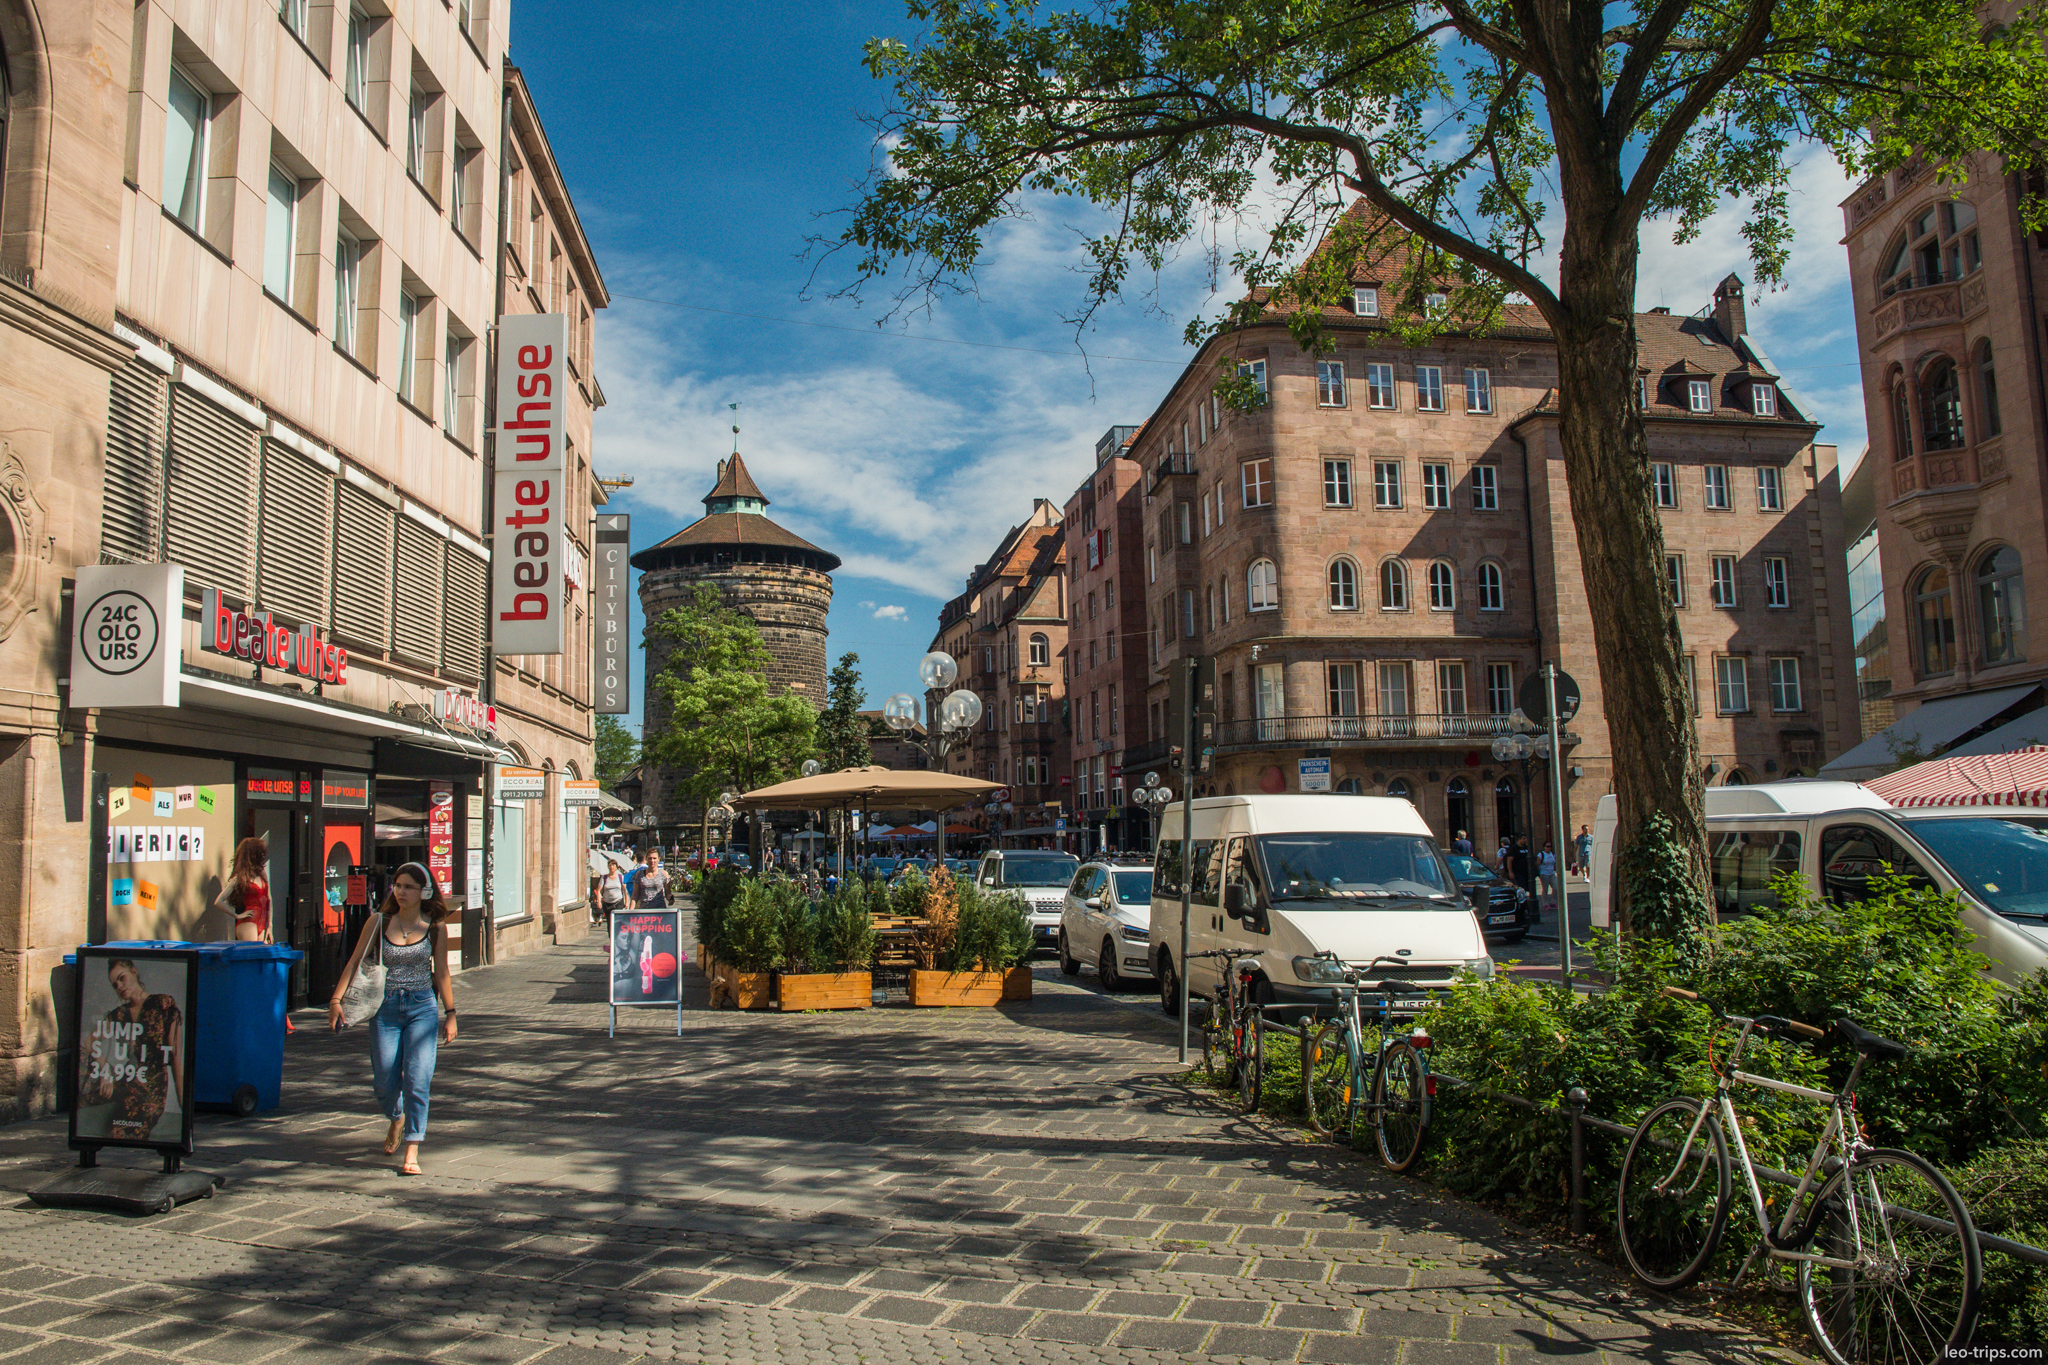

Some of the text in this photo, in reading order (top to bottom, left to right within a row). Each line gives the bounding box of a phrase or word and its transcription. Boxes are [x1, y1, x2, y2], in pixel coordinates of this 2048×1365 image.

[500, 344, 552, 621] beate uhse
[101, 605, 138, 623] 24C
[97, 624, 141, 642] OLO
[213, 588, 348, 686] beate uhse
[604, 548, 618, 708] CITYBÜROS
[99, 643, 138, 661] URS
[248, 773, 294, 794] beate uhse
[324, 785, 366, 798] SEX UP YOUR LIFE
[114, 797, 124, 809] ZU
[157, 801, 170, 809] ALS
[178, 793, 192, 802] NUR
[200, 793, 214, 806] HOLZ
[107, 834, 201, 853] IERIG?
[115, 888, 131, 897] DOCH
[620, 924, 672, 933] SHOPPING
[630, 916, 663, 925] HAPPY
[92, 1020, 144, 1041] JUMP
[90, 1061, 148, 1084] 34,99€
